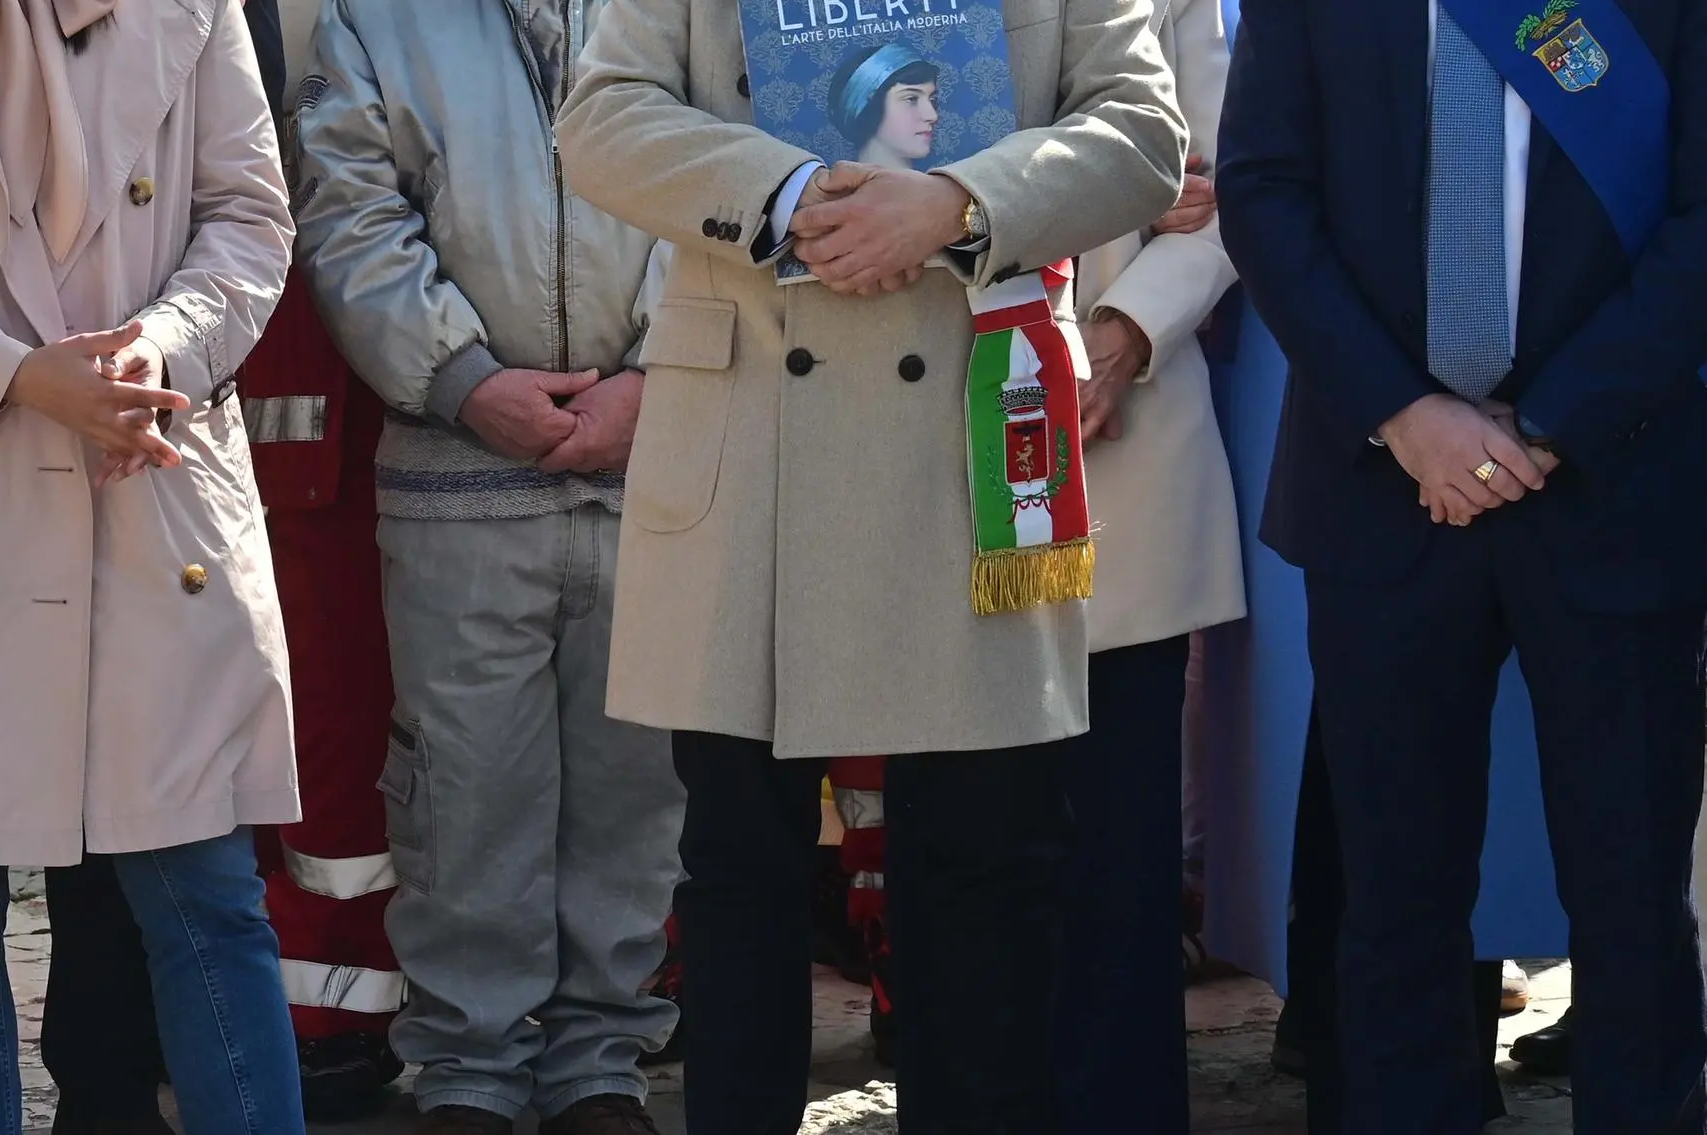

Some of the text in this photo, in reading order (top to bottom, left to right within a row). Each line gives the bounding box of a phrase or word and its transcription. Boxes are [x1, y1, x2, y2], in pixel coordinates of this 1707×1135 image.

[781, 13, 968, 46] L'ARTE DELL'ITALIA MODERNA
